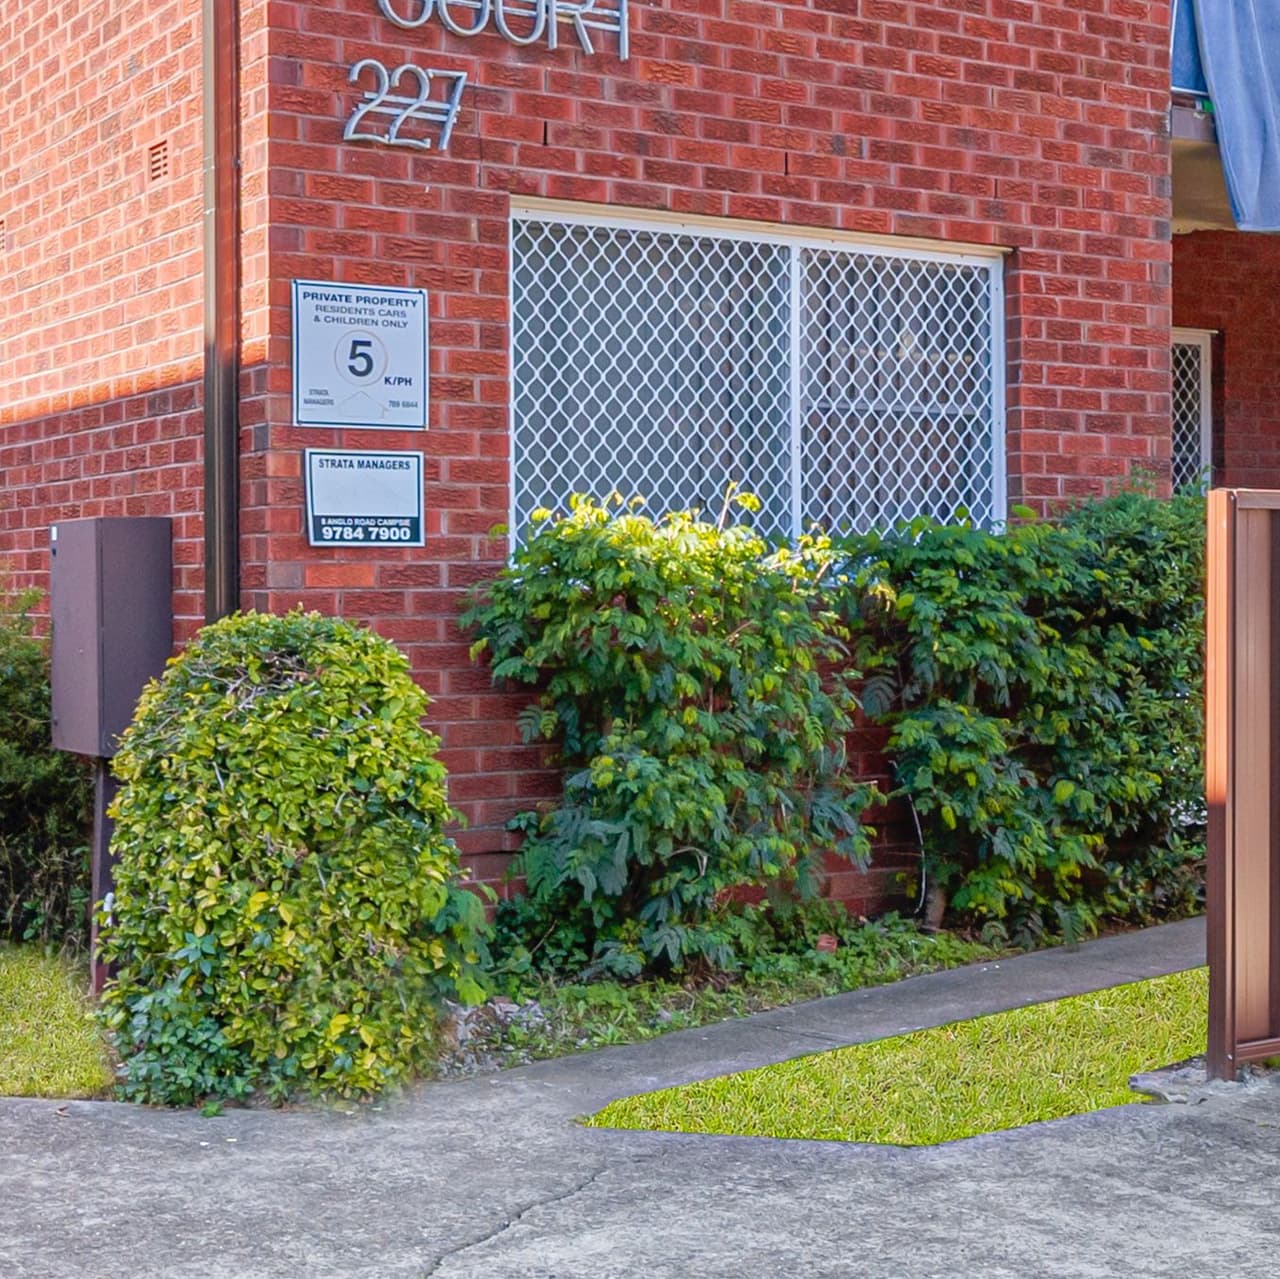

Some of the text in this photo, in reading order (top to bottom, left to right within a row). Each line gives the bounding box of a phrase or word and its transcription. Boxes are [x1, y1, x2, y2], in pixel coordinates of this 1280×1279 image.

[343, 58, 467, 150] 227
[303, 291, 418, 308] PRIVATE PROPERTY
[315, 304, 407, 318] RESIDENTS CARS
[324, 315, 378, 327] CHILDREN
[381, 319, 409, 329] ONLY
[348, 339, 373, 377] 5
[384, 376, 412, 386] K/PH
[319, 458, 411, 470] STRATA MANAGERS
[354, 518, 376, 526] ROAD
[322, 526, 411, 540] 9784 7900
